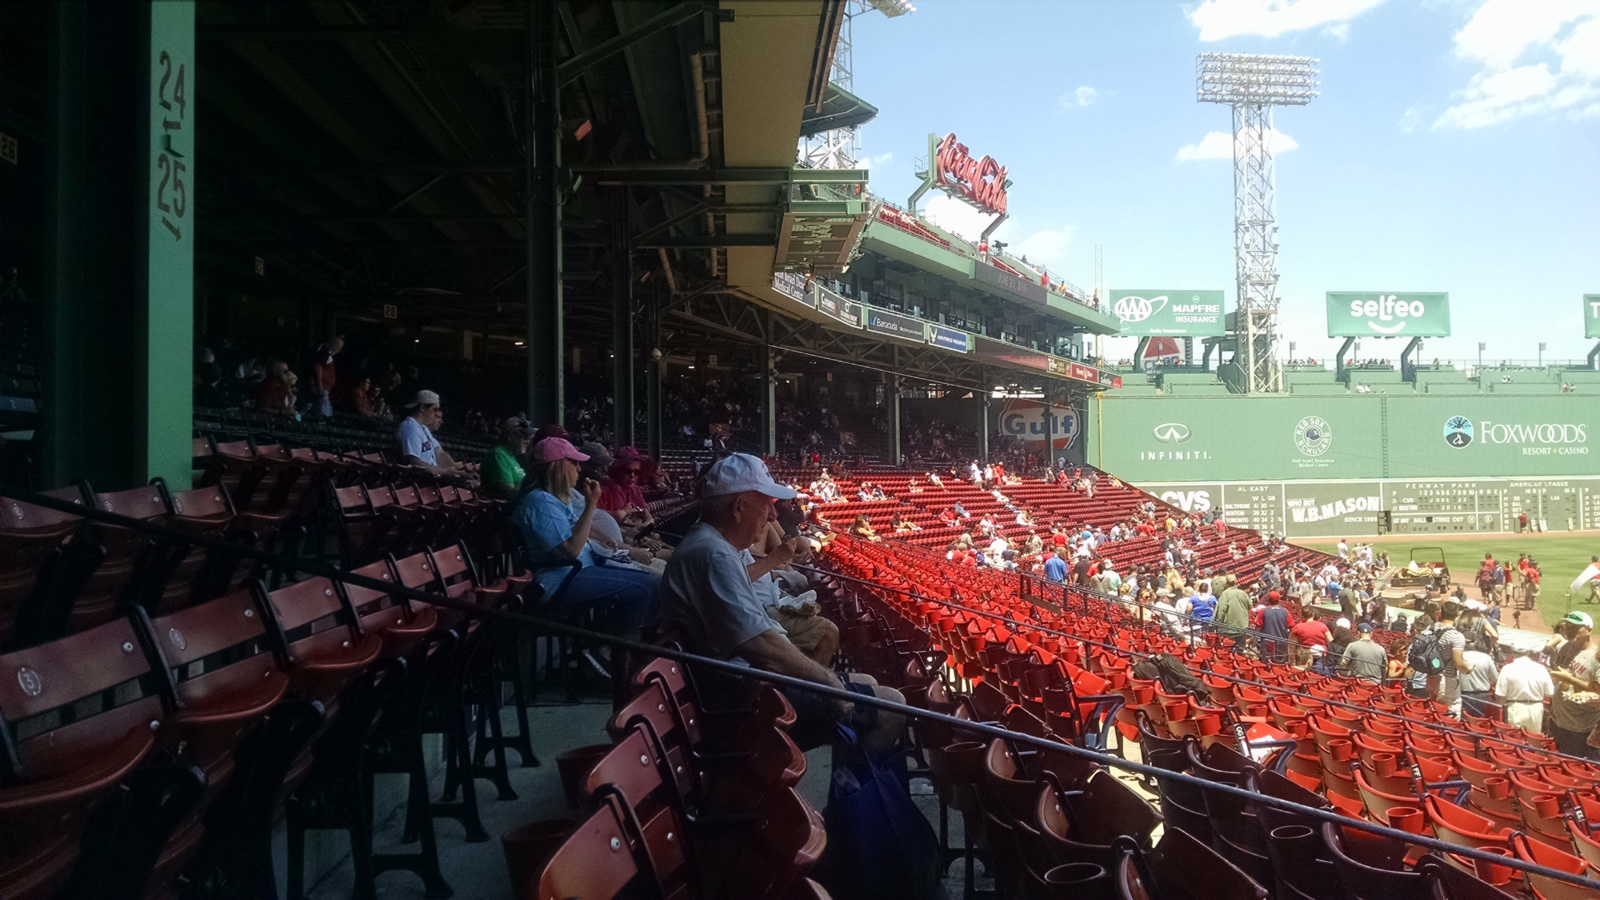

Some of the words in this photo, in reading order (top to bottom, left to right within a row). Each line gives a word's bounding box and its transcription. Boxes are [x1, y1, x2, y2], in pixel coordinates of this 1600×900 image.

[160, 50, 185, 120] 24
[158, 153, 186, 218] 25
[775, 277, 791, 294] Medical
[791, 286, 804, 301] Center
[386, 307, 395, 317] 28
[1119, 297, 1147, 321] AAA
[877, 318, 898, 331] Barracuda
[1005, 413, 1074, 435] Gulf
[1296, 420, 1309, 435] RED
[1310, 418, 1325, 428] SOX
[1480, 421, 1587, 444] FOXWOODS
[1522, 447, 1551, 455] RESORT
[1559, 447, 1589, 455] CASINO
[1160, 491, 1211, 512] CVS
[1292, 496, 1380, 523] W.B.MASON
[23, 673, 35, 689] 3
